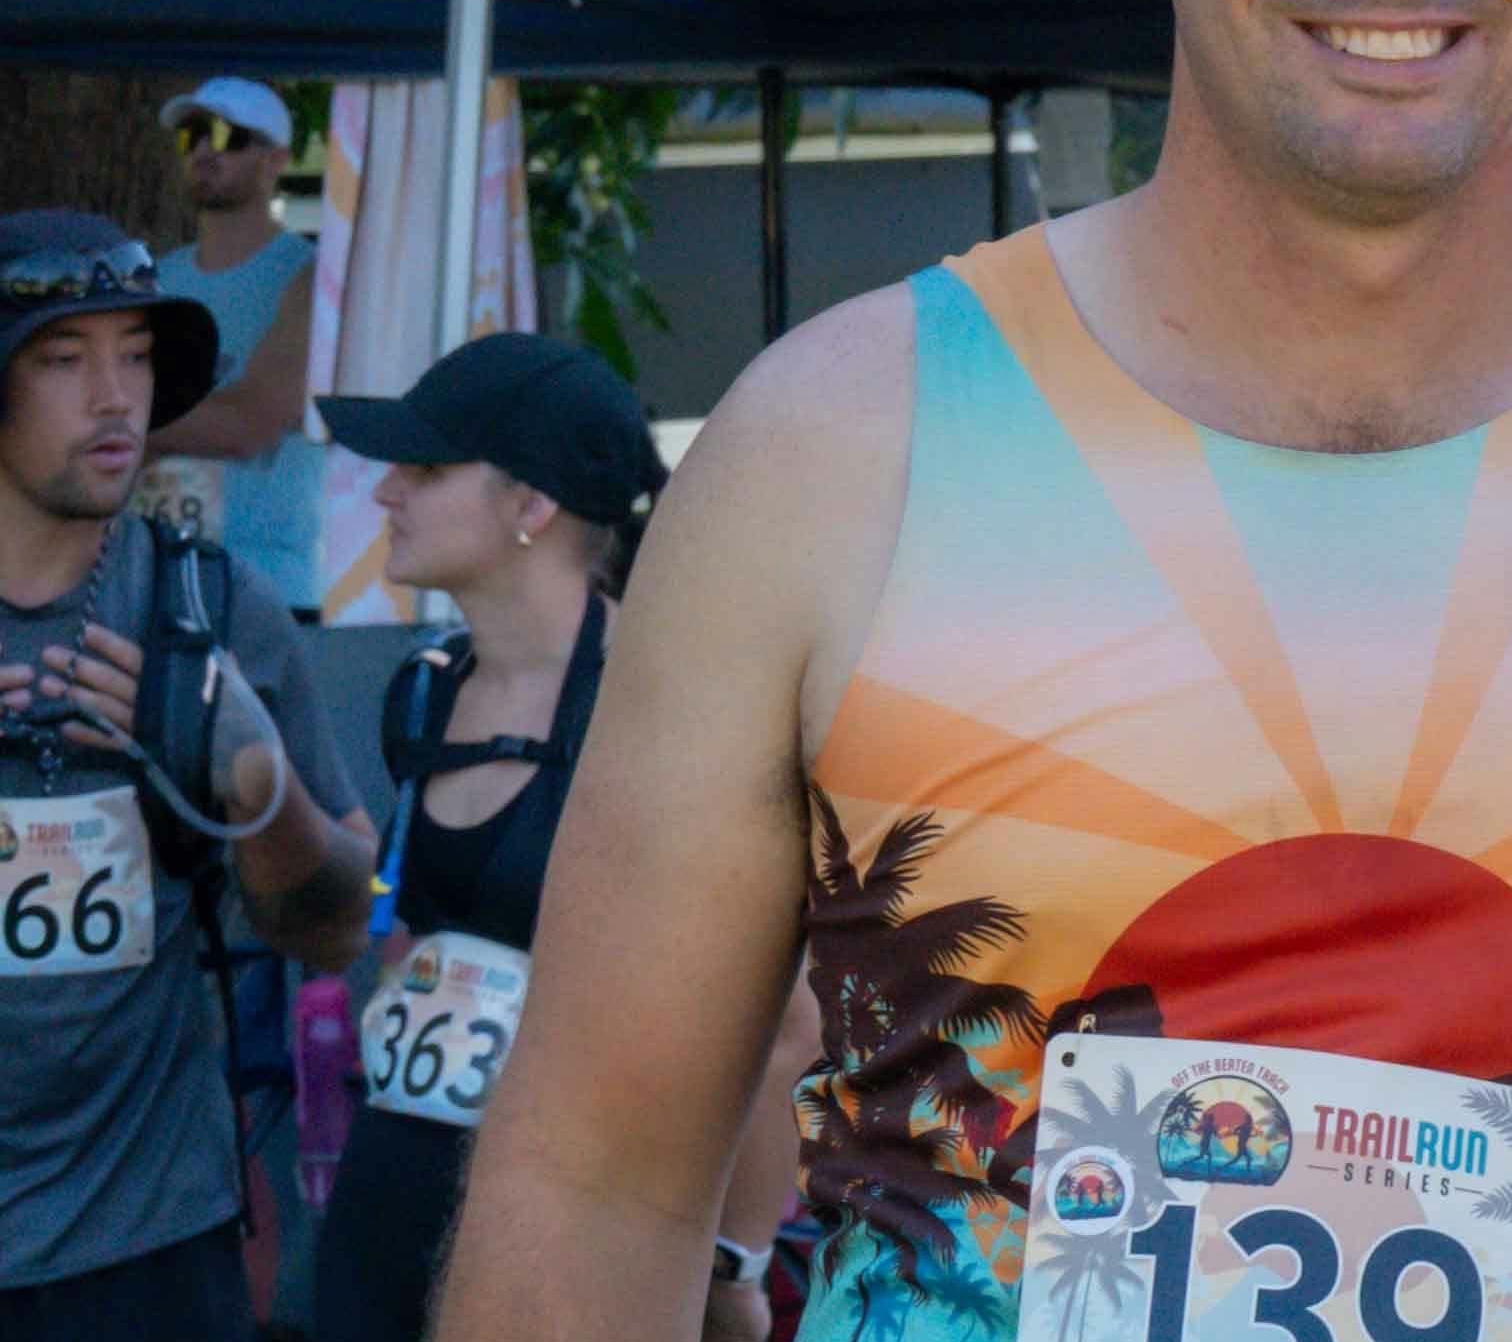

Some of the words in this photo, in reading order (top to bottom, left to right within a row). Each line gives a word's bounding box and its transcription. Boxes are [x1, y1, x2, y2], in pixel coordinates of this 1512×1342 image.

[374, 1002, 511, 1109] 363
[1191, 1058, 1213, 1077] THE
[1214, 1057, 1254, 1078] BEATEN
[1314, 1103, 1490, 1178] TRAILRUN
[1343, 1161, 1453, 1198] SERIES
